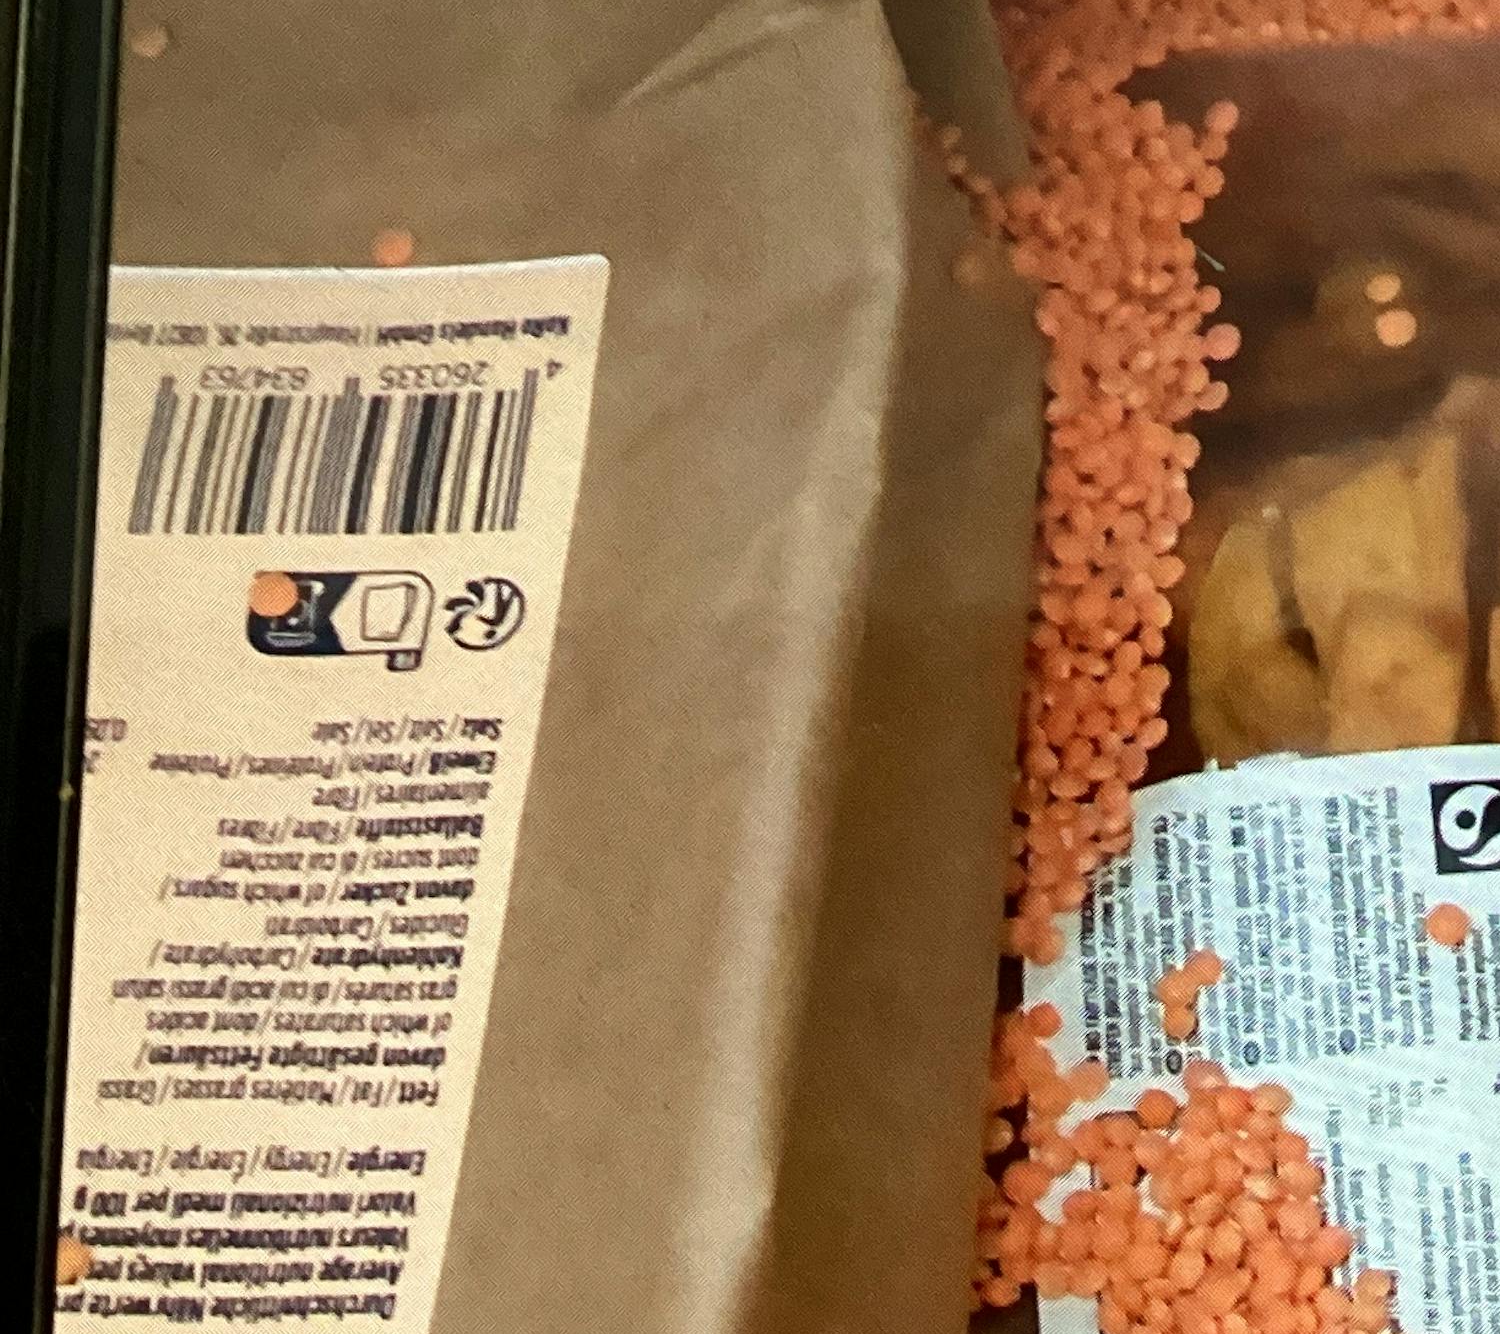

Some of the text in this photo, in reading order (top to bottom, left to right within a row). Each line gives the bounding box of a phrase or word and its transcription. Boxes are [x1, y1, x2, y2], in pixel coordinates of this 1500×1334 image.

[198, 358, 563, 390] 4 260335 834763
[381, 1045, 445, 1070] davon
[130, 1186, 167, 1212] per
[171, 1192, 224, 1217] medi
[229, 1192, 352, 1219] nutrizionali
[354, 1191, 414, 1217] Valori
[185, 1227, 332, 1254] nutritionnelles
[336, 1226, 407, 1251] Valeurs
[199, 1261, 312, 1288] nutritional
[317, 1255, 402, 1285] Average
[87, 1293, 394, 1323] Durchschnittliche Nährwerte
